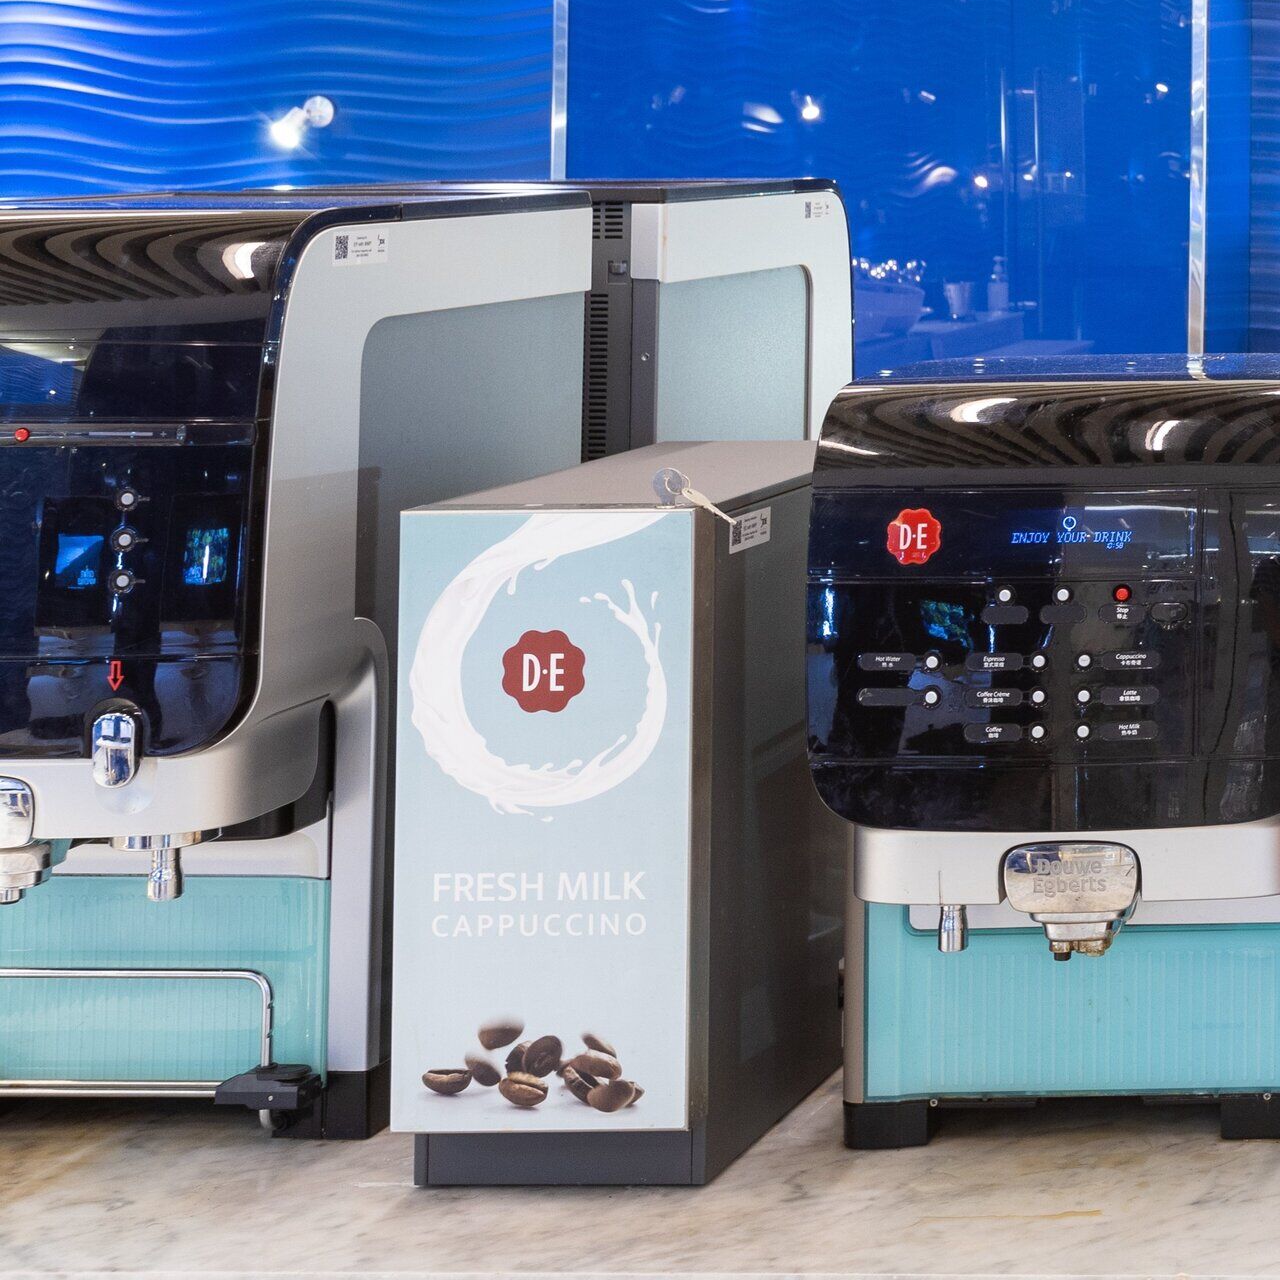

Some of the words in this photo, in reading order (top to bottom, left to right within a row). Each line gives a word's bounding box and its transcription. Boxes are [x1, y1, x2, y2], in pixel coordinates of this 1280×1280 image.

[1011, 532, 1049, 544] ENJOY
[1057, 531, 1087, 543] YOUR
[1093, 531, 1132, 543] DRINK
[1036, 858, 1102, 875] Douwe
[433, 872, 544, 902] FRESH
[557, 871, 646, 901] MILK
[1033, 876, 1107, 898] Egberts
[431, 912, 647, 938] CAPPUCCINO
